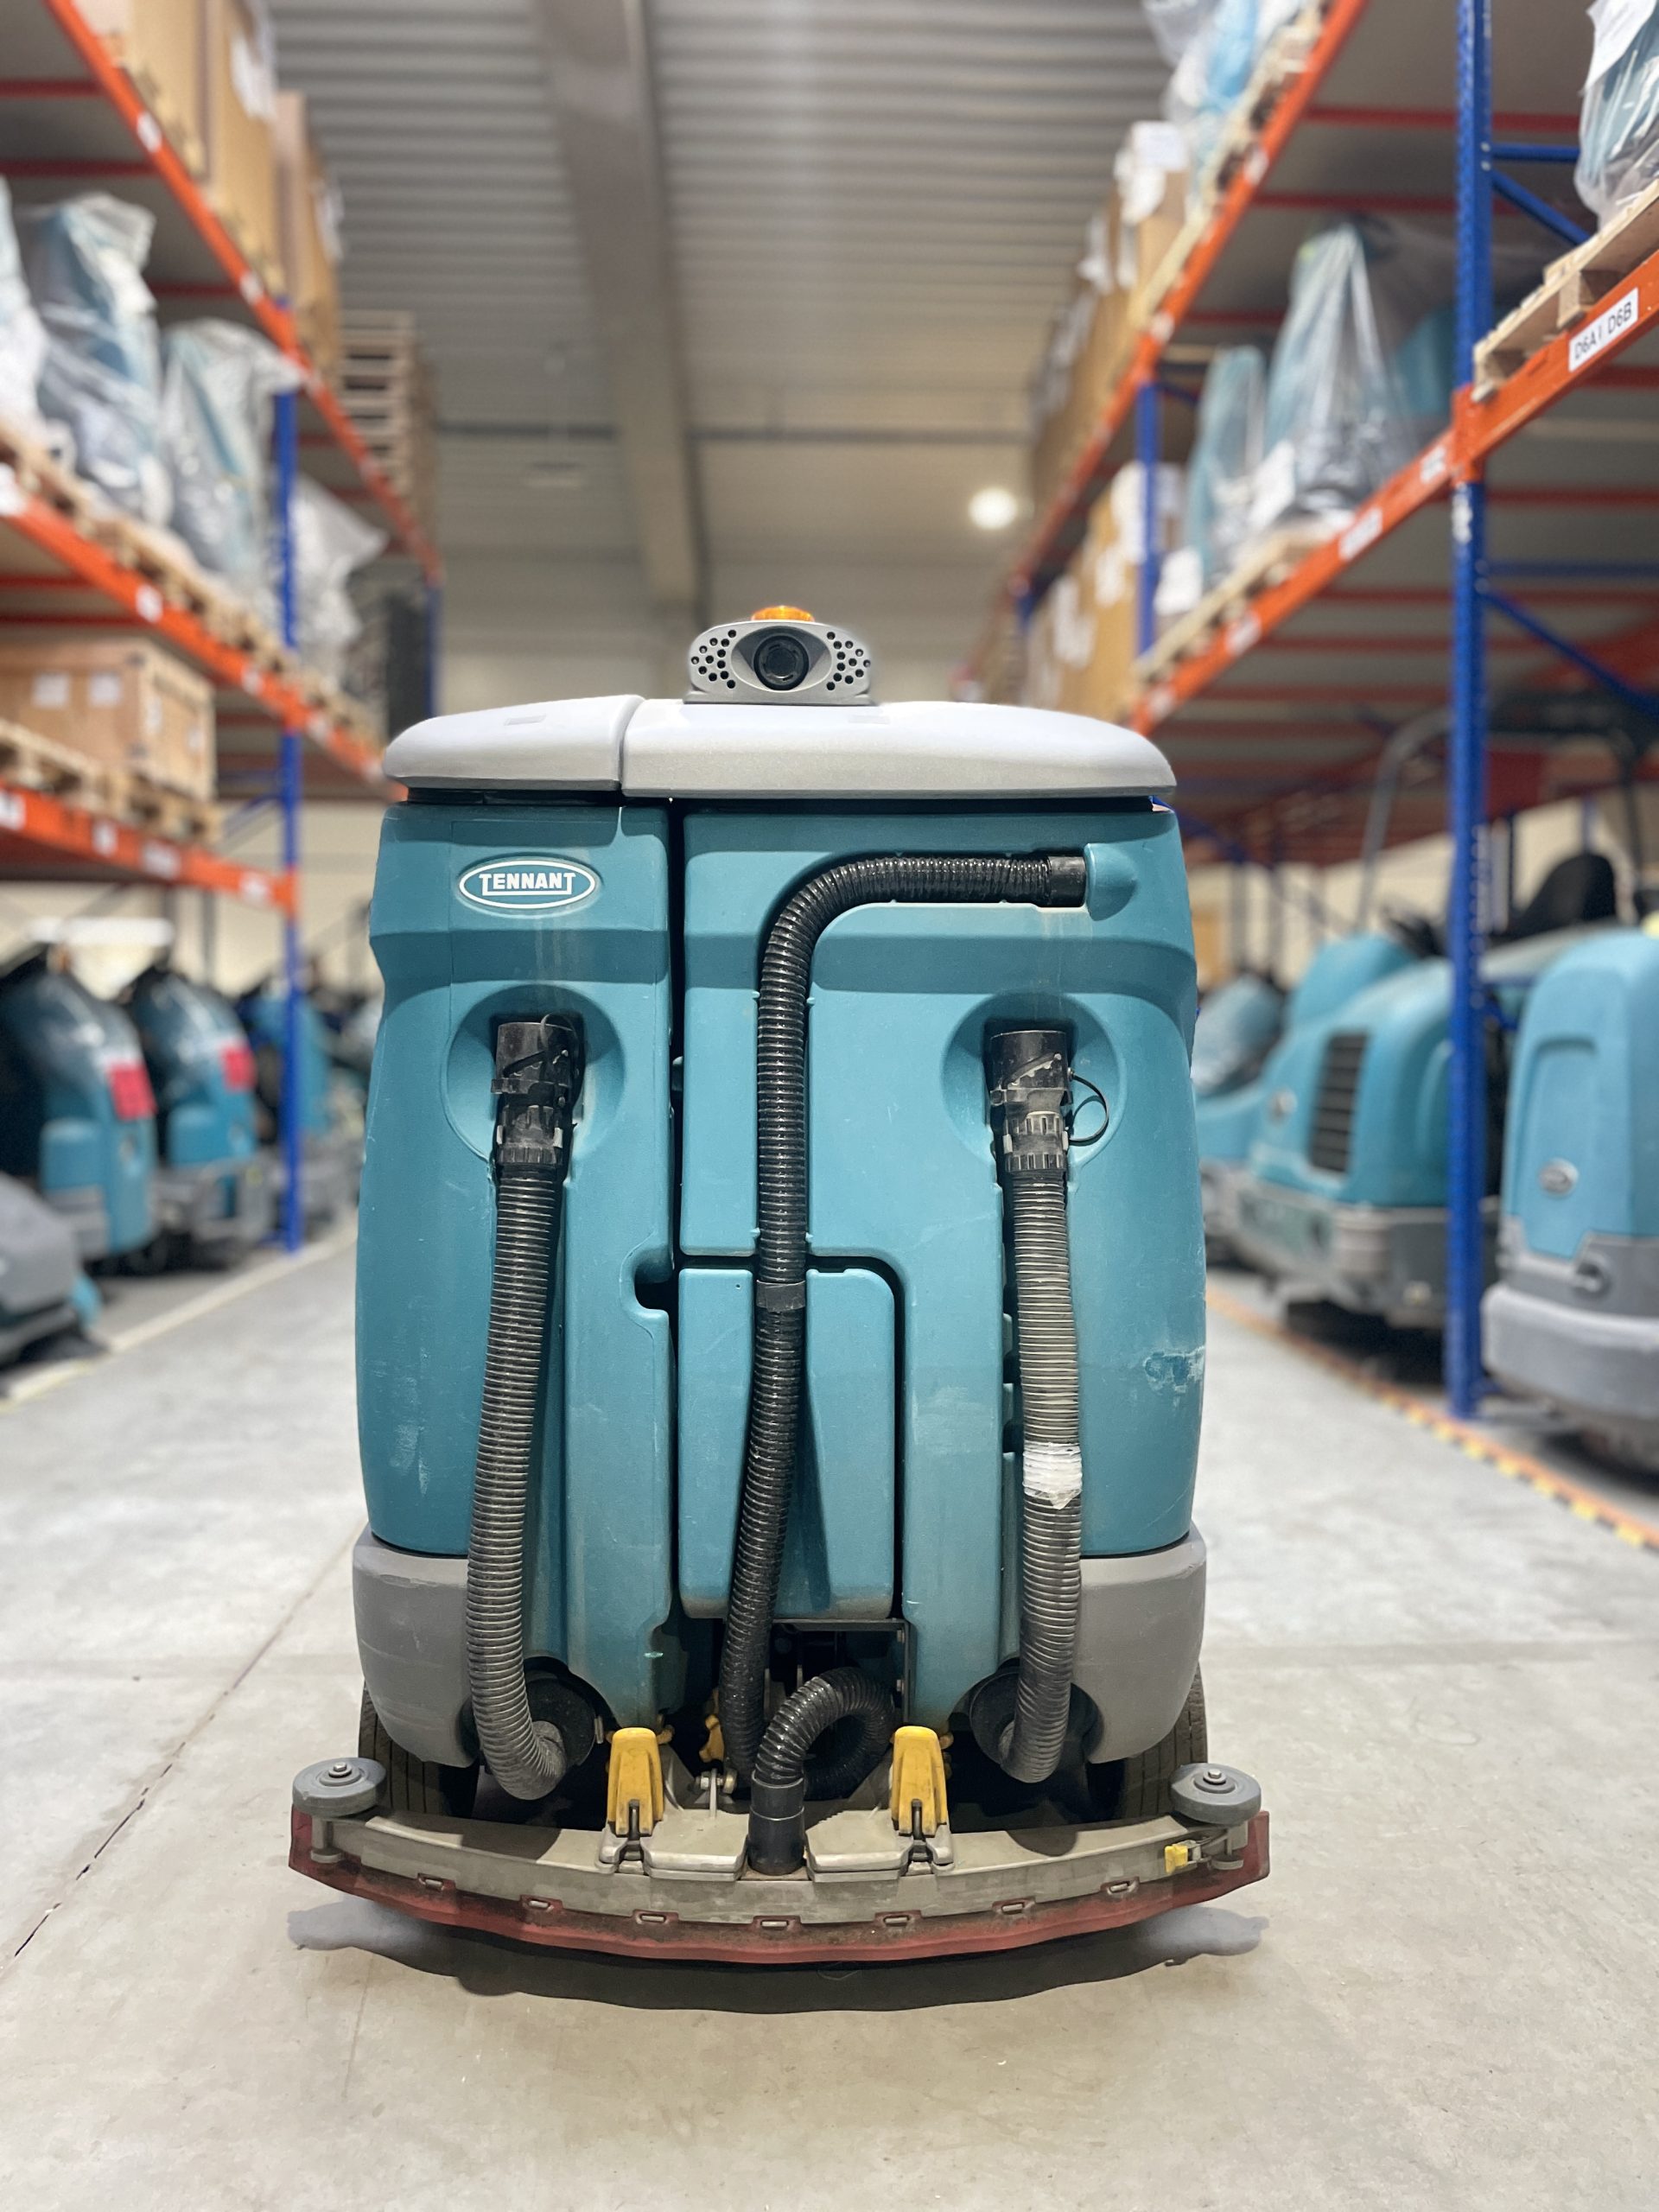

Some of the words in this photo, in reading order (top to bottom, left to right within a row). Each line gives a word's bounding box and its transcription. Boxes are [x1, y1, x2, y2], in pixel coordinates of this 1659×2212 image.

[1575, 332, 1596, 359] D6A
[1608, 302, 1631, 334] D6B
[479, 872, 576, 896] TENNANT
